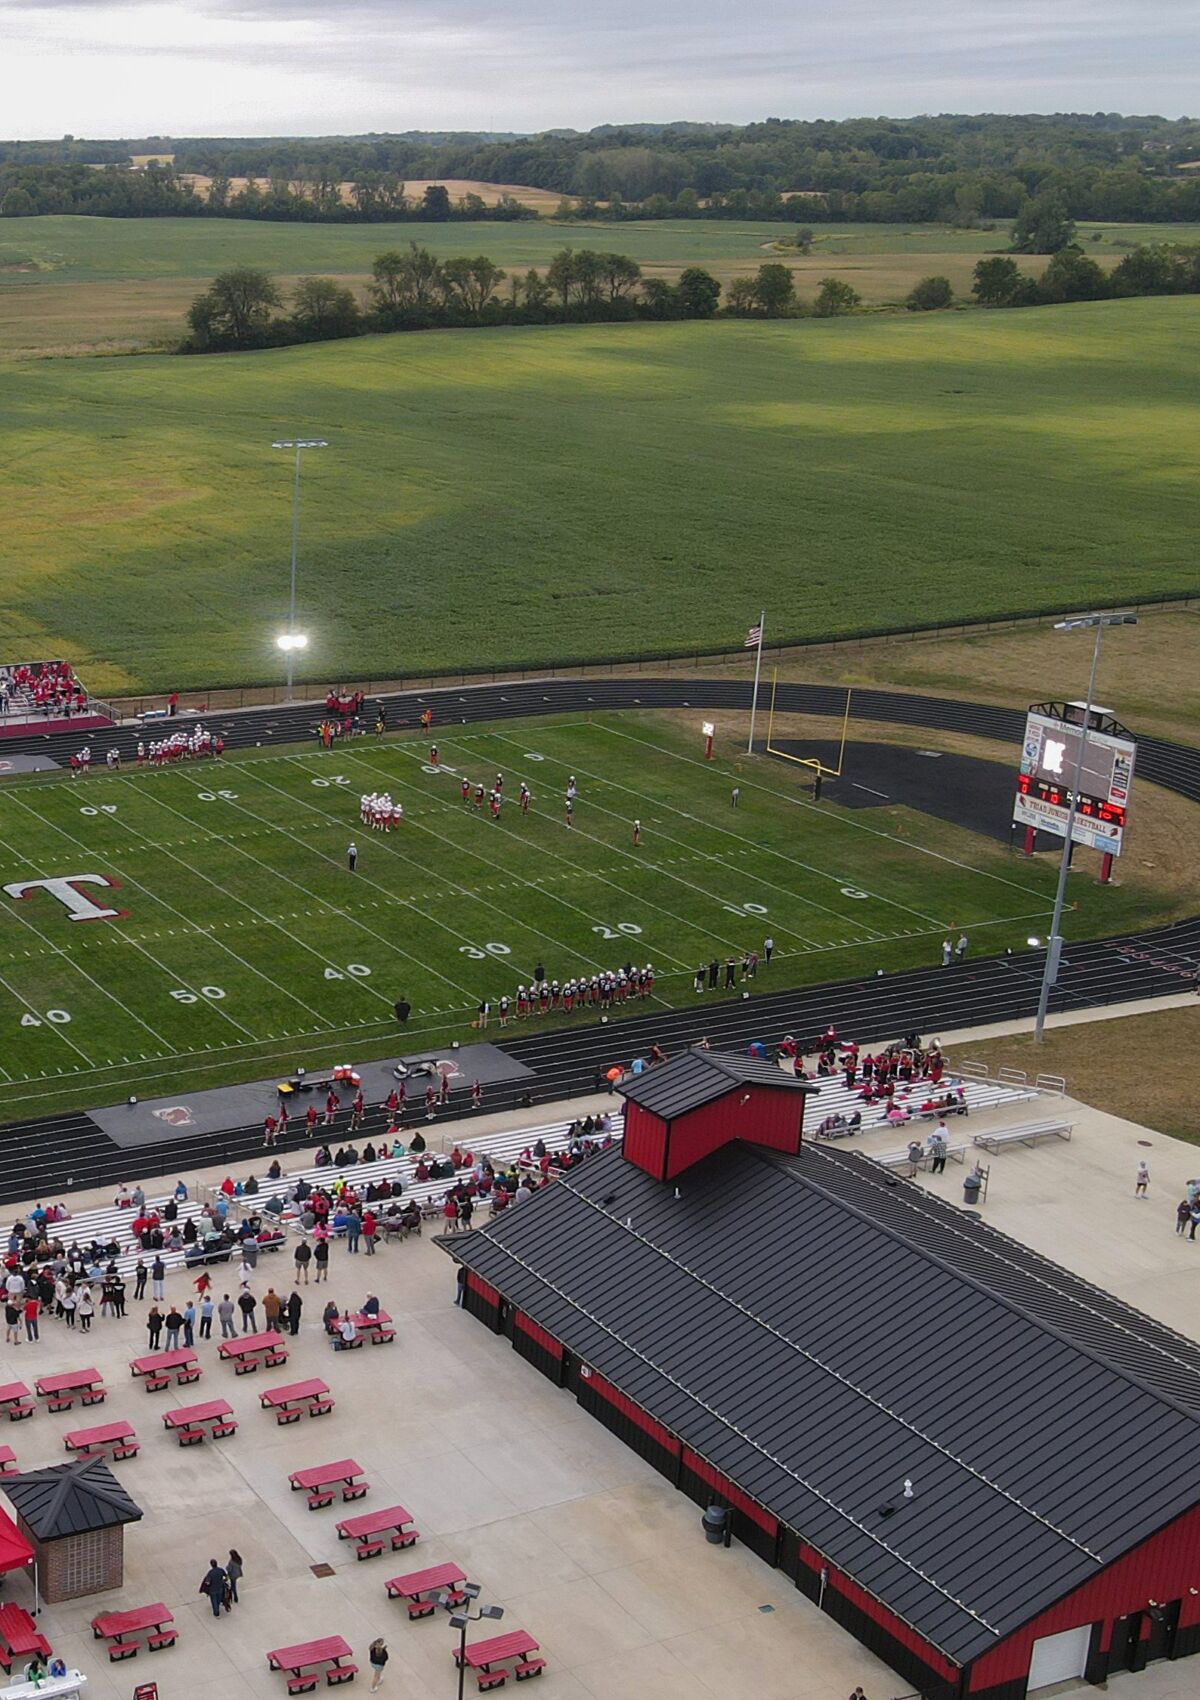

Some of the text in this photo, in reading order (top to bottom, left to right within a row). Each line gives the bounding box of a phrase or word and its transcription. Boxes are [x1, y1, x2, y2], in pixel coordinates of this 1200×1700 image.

[420, 764, 457, 774] 10
[311, 775, 351, 787] 20
[197, 790, 239, 801] 30
[79, 804, 117, 816] 40
[1073, 814, 1106, 834] ASKETBALL
[1, 873, 130, 922] T
[839, 887, 869, 899] G
[722, 903, 768, 917] 10
[591, 922, 642, 940] 20
[459, 942, 511, 960] 30
[324, 963, 371, 980] 40
[169, 985, 227, 1005] 50
[20, 1009, 72, 1028] 40
